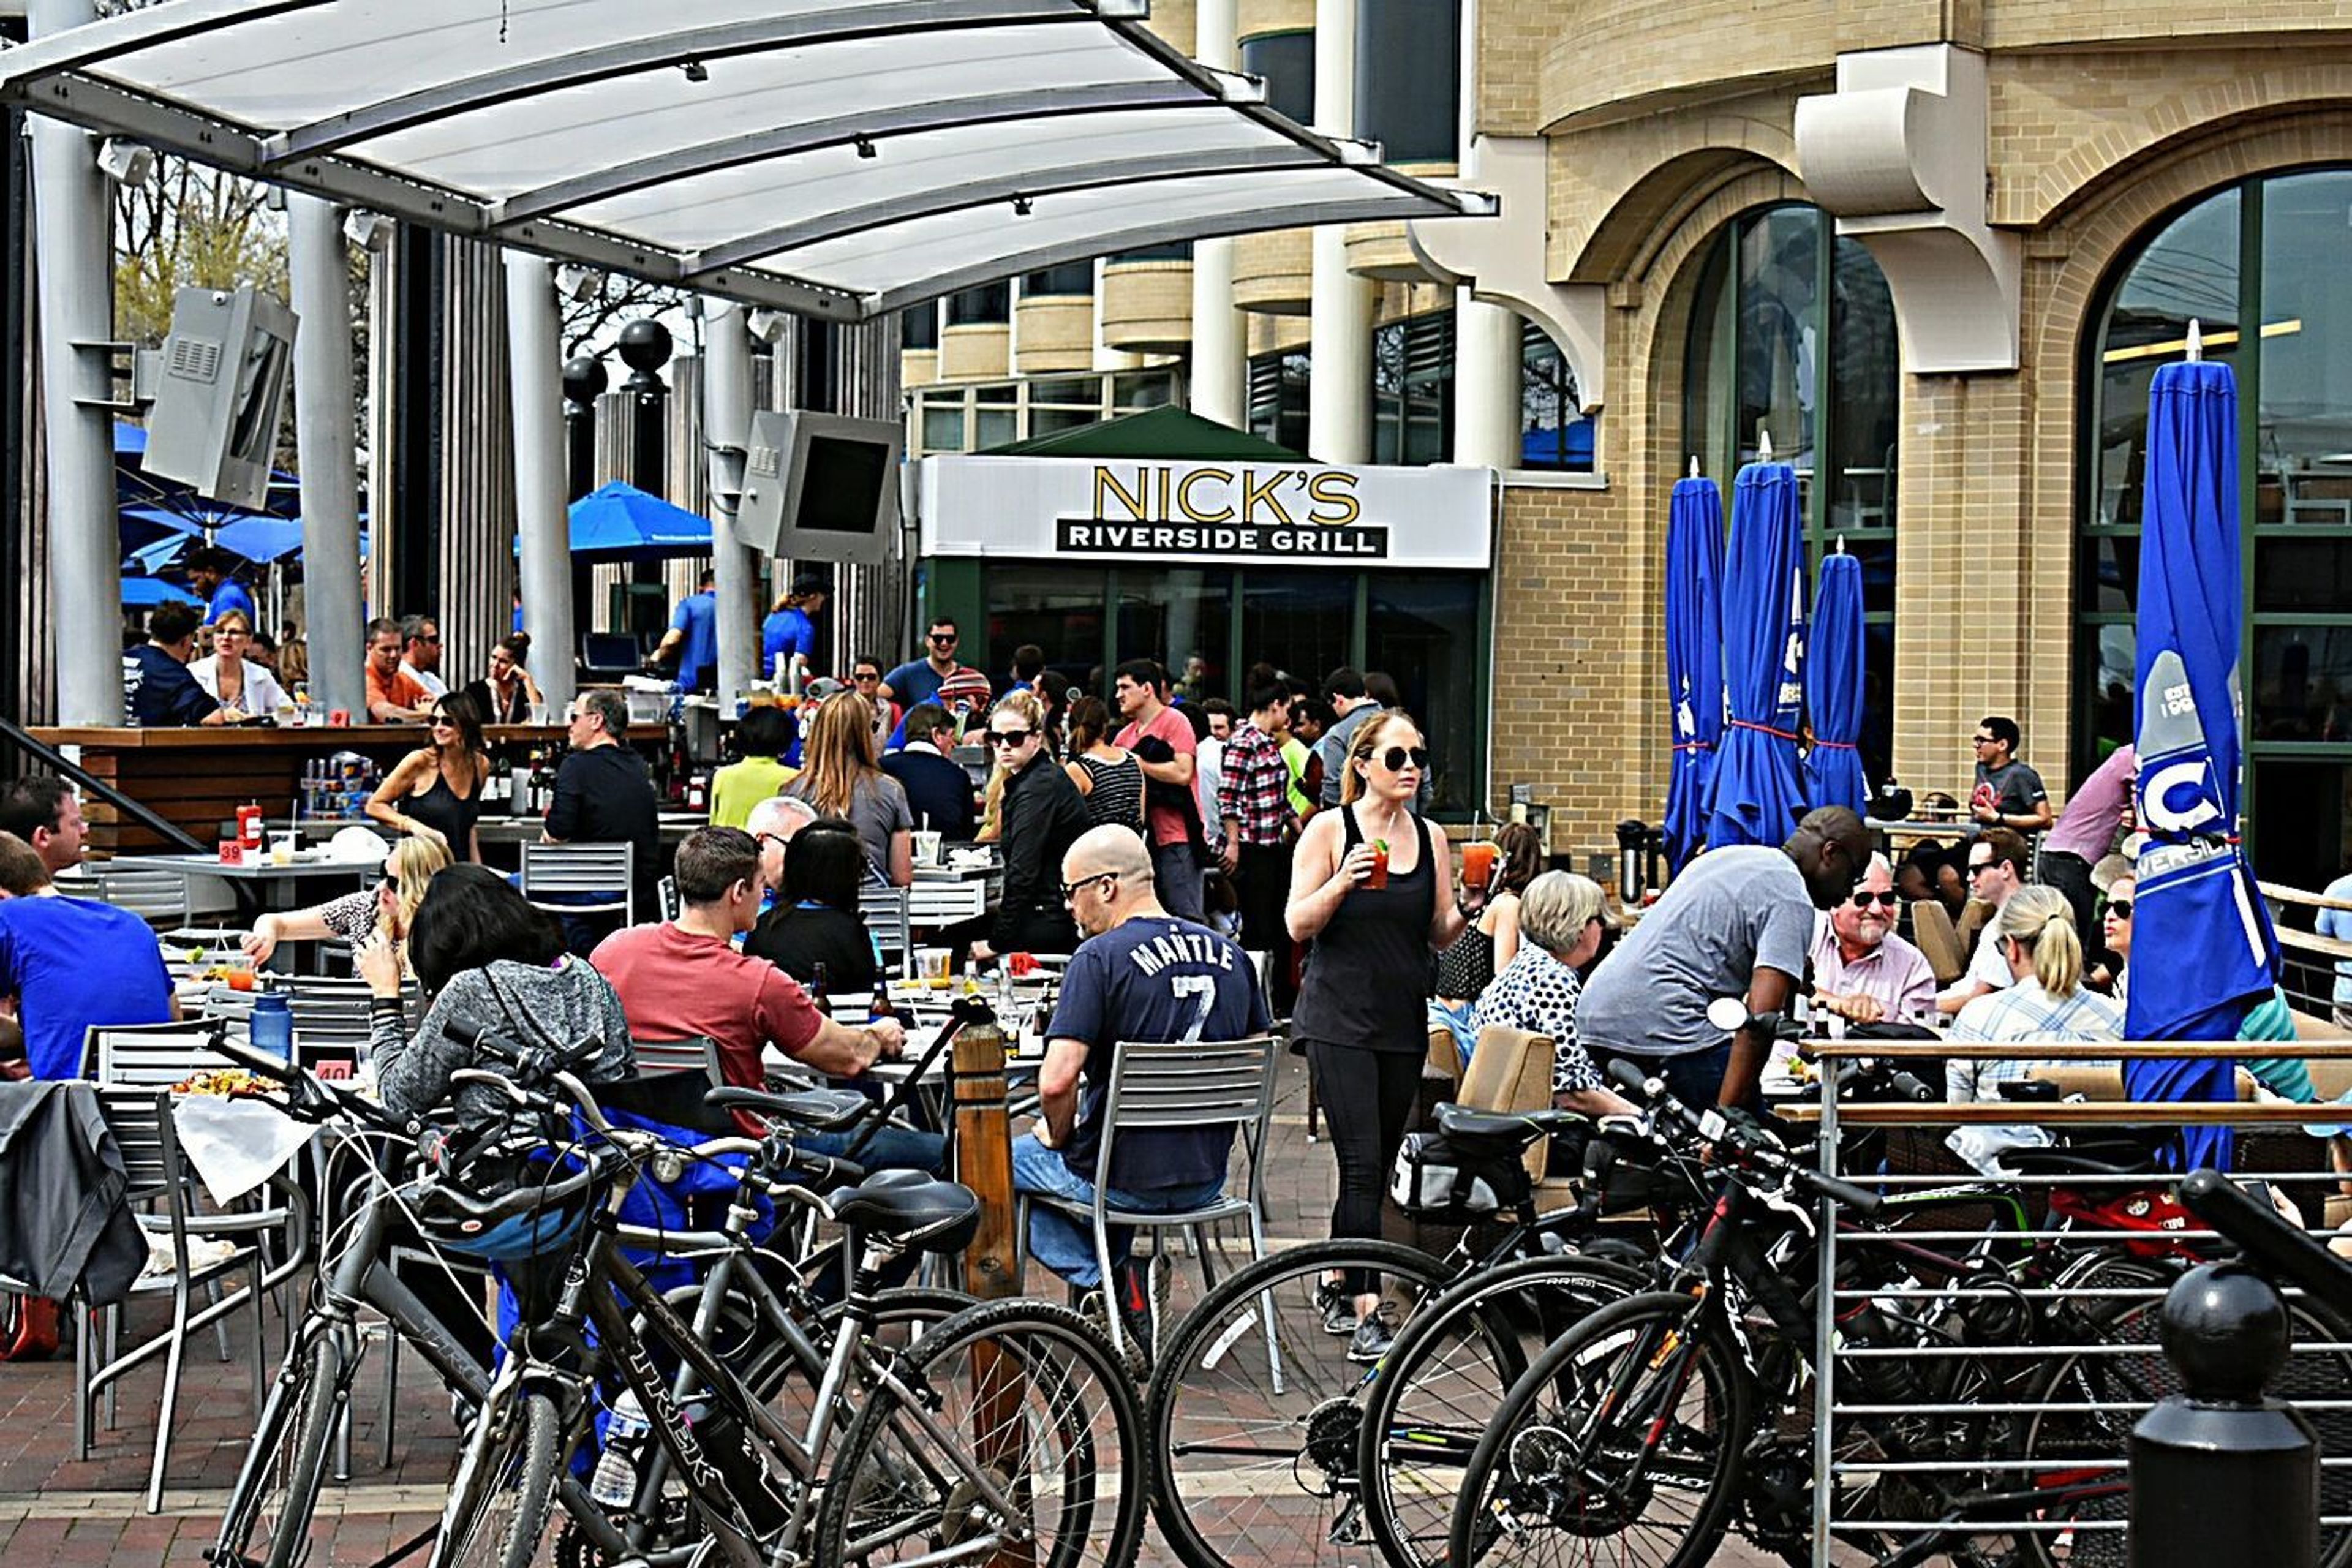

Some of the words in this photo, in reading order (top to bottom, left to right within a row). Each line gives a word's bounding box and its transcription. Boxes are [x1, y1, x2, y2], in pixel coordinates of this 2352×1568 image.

[1093, 466, 1360, 526] NICK'S
[1068, 525, 1257, 549] RIVERSIDE
[1270, 530, 1376, 553] GRILL
[221, 846, 241, 859] 39
[1129, 933, 1233, 977] MANTLE
[1171, 974, 1216, 1044] 7
[629, 1337, 717, 1488] TREK
